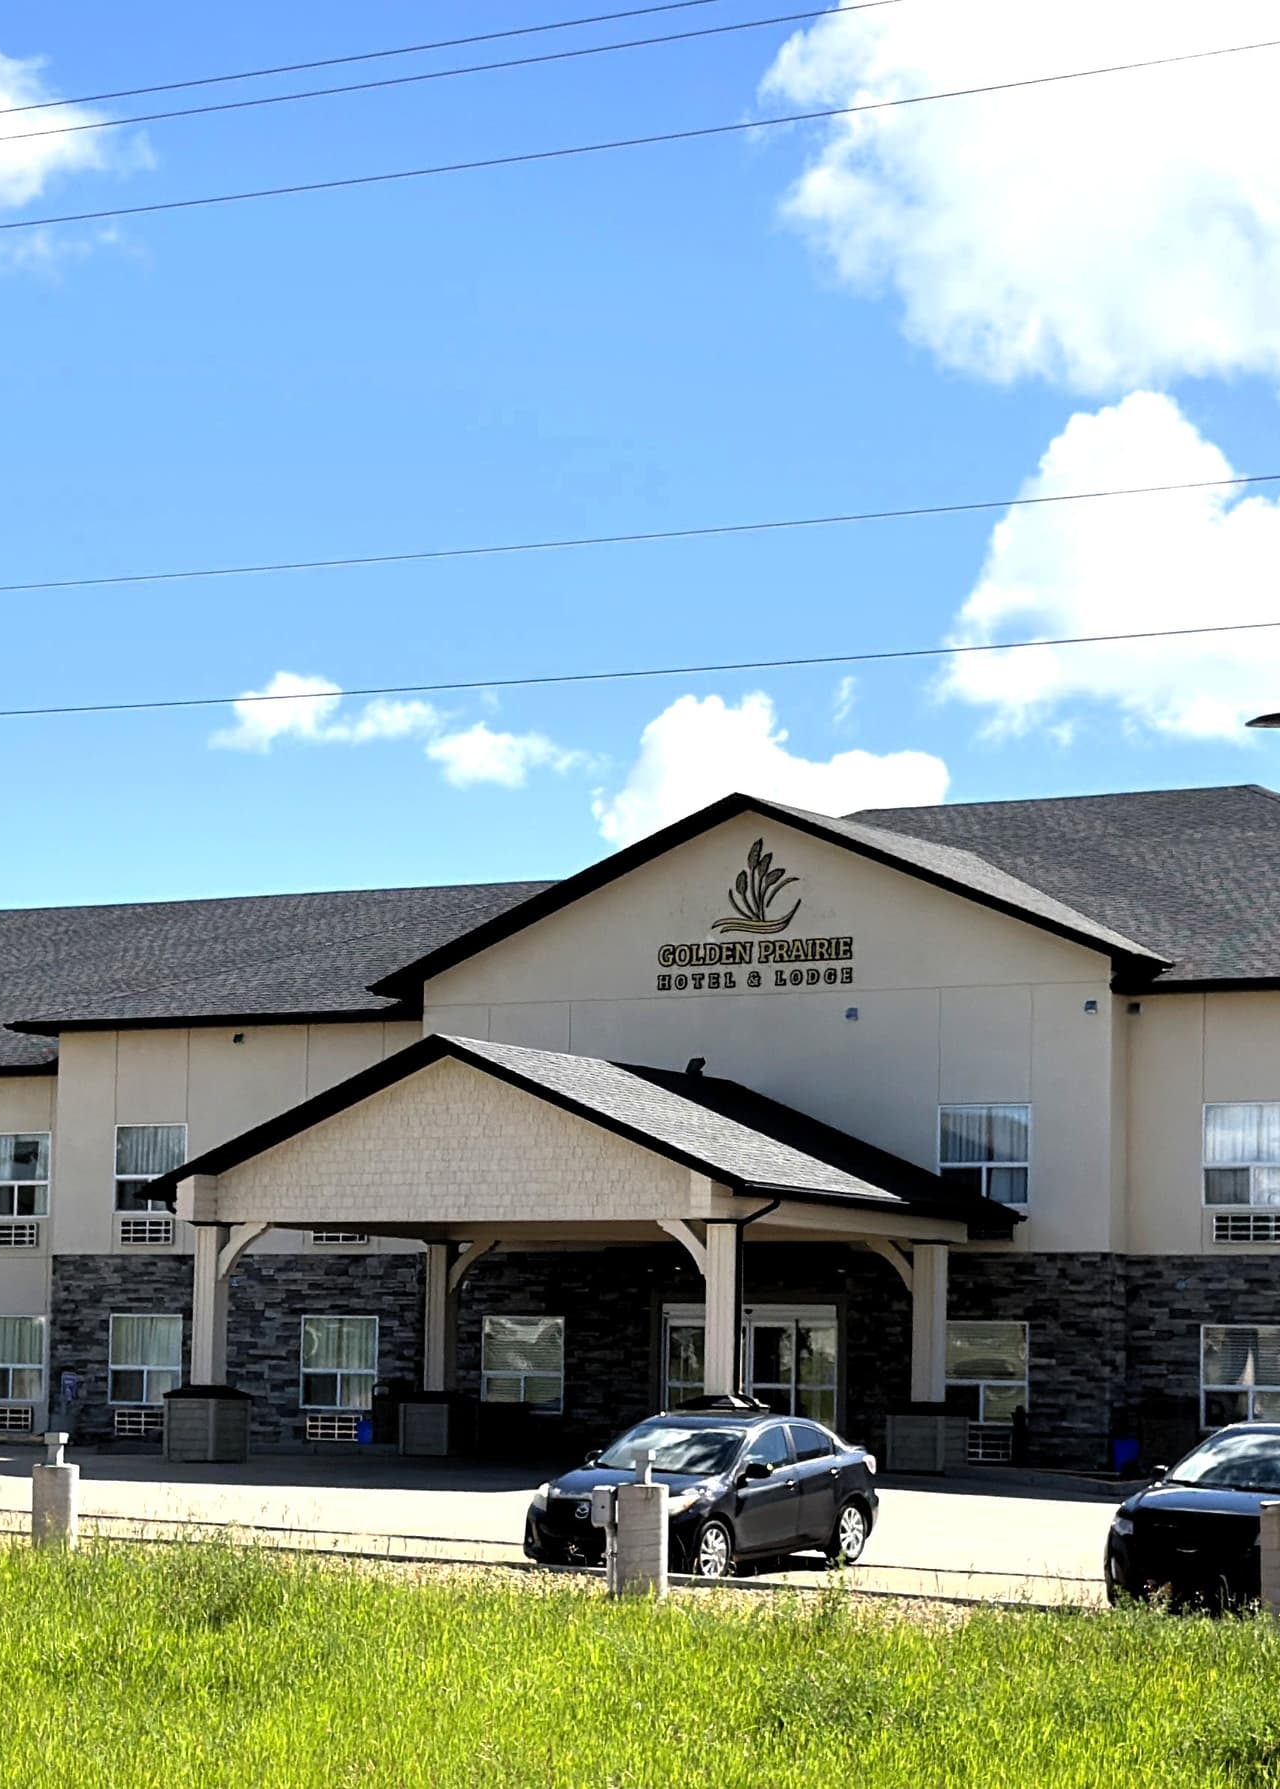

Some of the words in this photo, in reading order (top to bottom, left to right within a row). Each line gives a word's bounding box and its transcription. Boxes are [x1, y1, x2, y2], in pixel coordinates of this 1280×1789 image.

[658, 941, 753, 967] GOLDEN
[758, 937, 853, 963] PRAIRIE
[657, 972, 736, 991] HOTEL
[747, 971, 761, 988] &
[775, 967, 853, 986] LODGE
